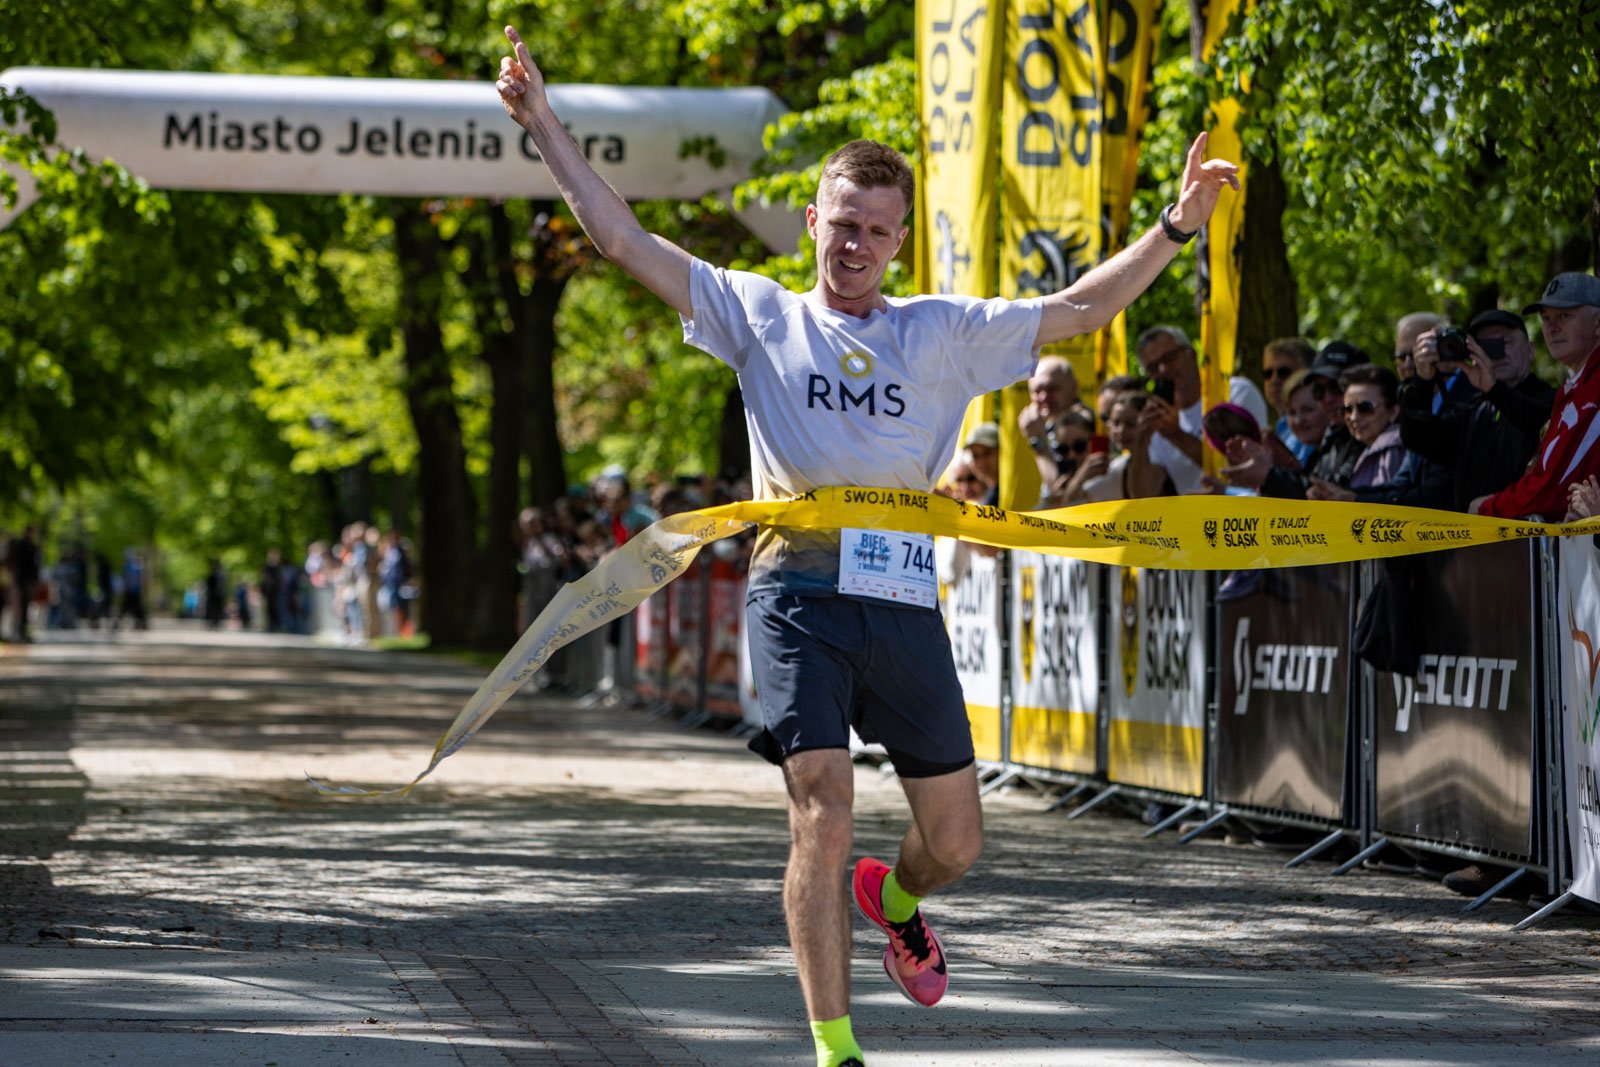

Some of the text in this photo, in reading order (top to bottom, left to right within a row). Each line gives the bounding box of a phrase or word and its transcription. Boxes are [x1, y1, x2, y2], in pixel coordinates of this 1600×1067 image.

[164, 111, 322, 153] Miasto
[336, 116, 503, 160] Jelenia
[808, 374, 905, 417] RMS
[844, 490, 929, 512] SWOJĄ TRASĘ
[1223, 518, 1259, 532] DOLNY
[1224, 531, 1259, 549] ŚLĄSK
[1271, 534, 1328, 547] SWOJĄ TRASĘ
[902, 541, 934, 576] 744
[1252, 644, 1339, 694] SCOTT
[1414, 654, 1518, 711] SCOTT
